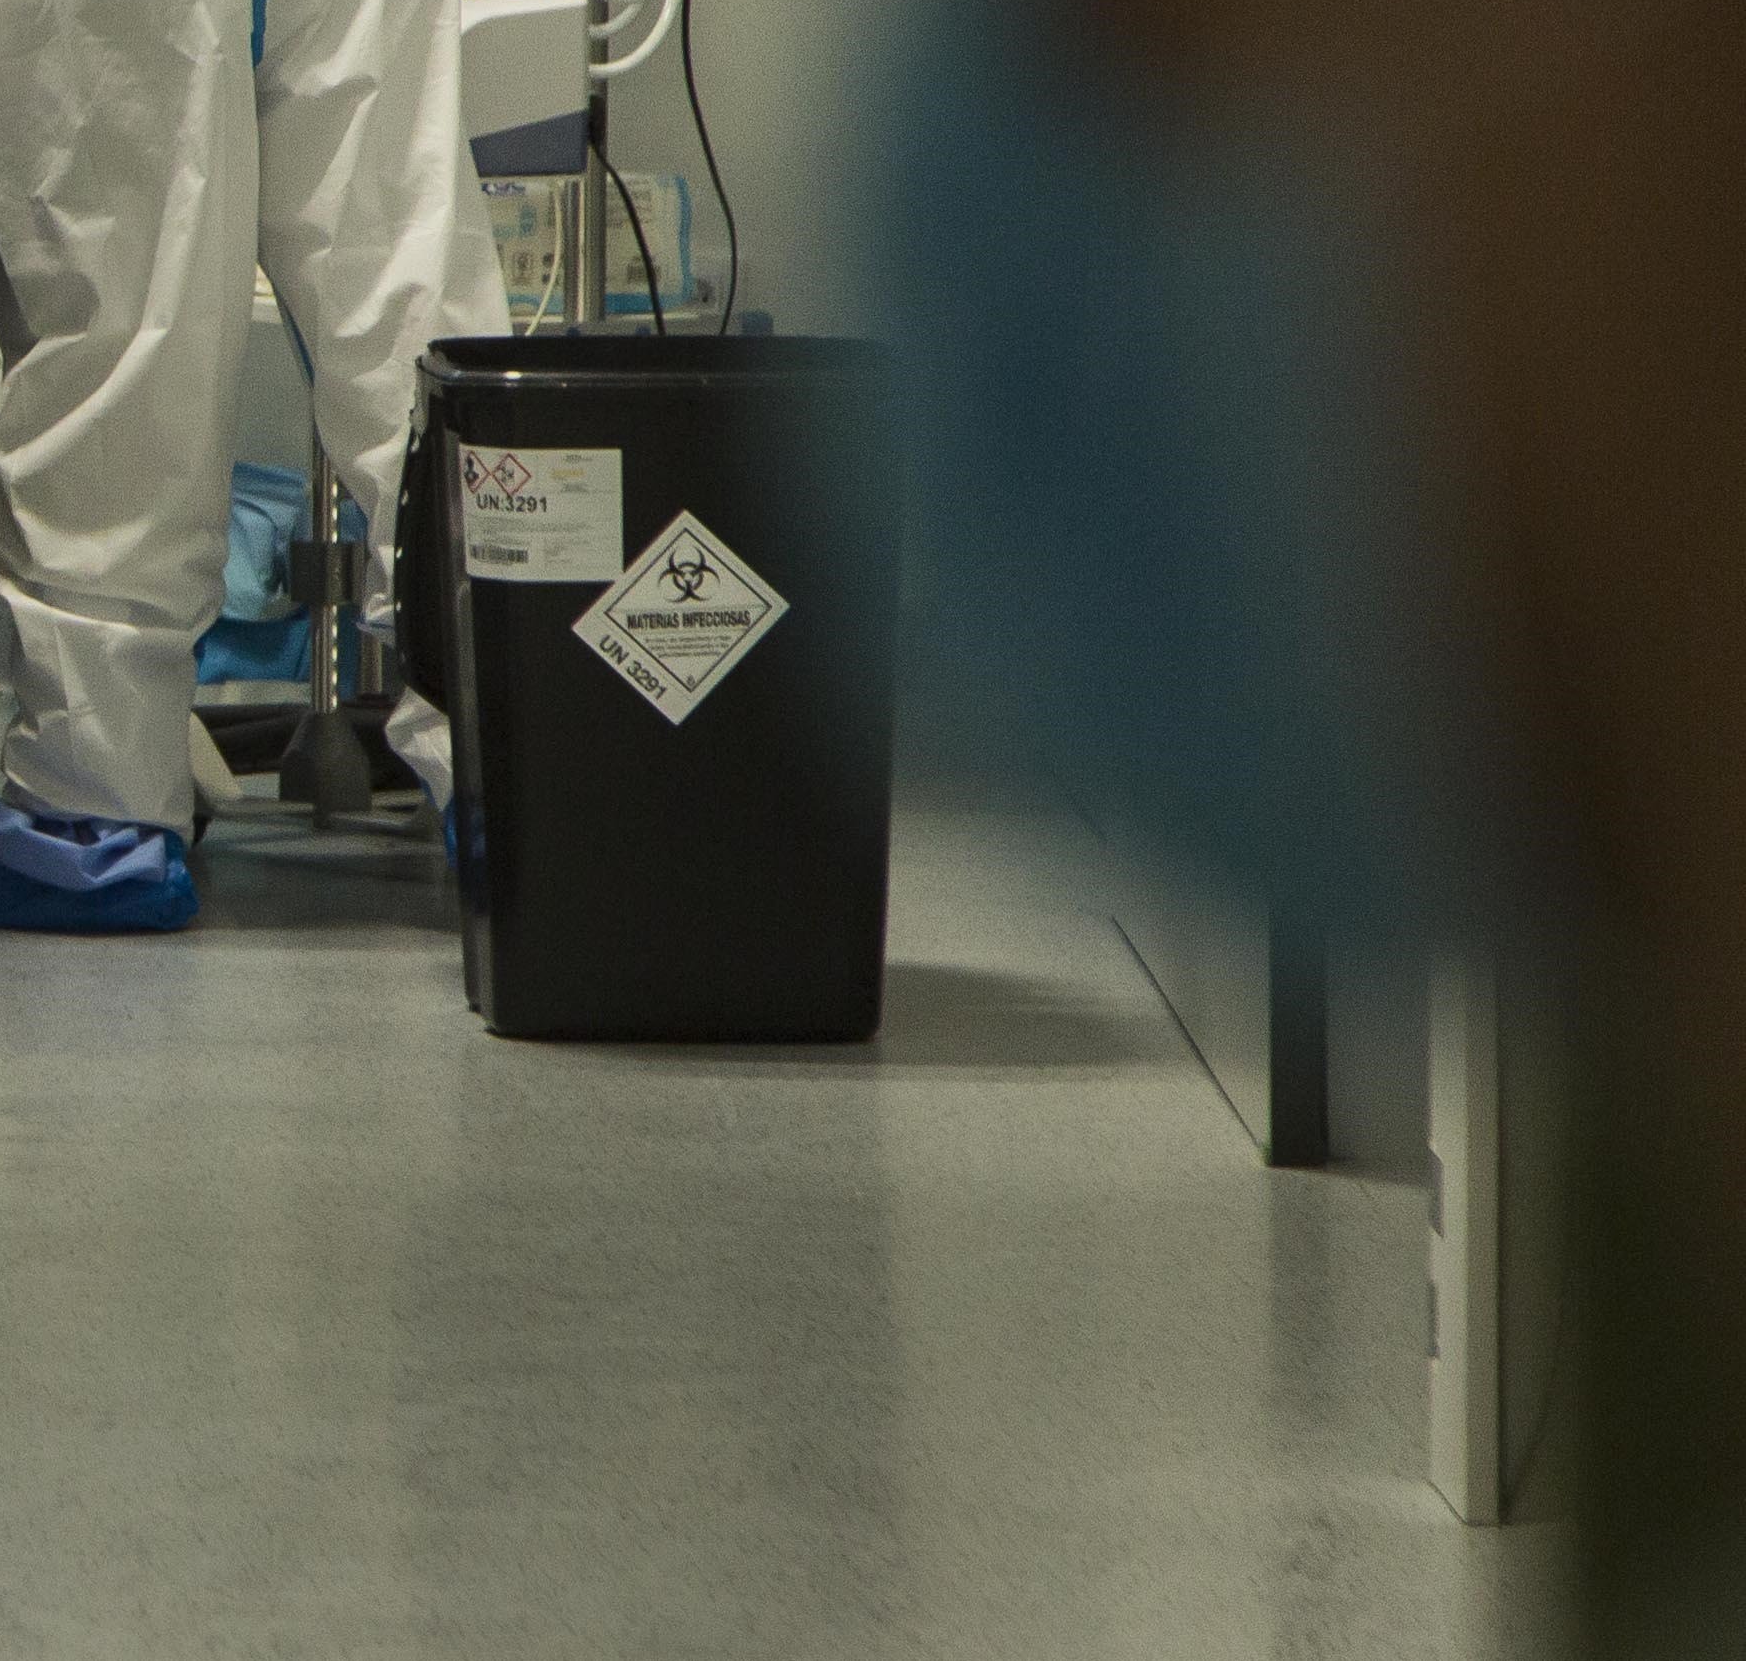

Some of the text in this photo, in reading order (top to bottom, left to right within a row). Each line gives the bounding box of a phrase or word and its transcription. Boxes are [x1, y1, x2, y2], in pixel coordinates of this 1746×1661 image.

[627, 609, 751, 630] MATERIAS INFECCIOSAS
[598, 634, 668, 701] UN 3291
